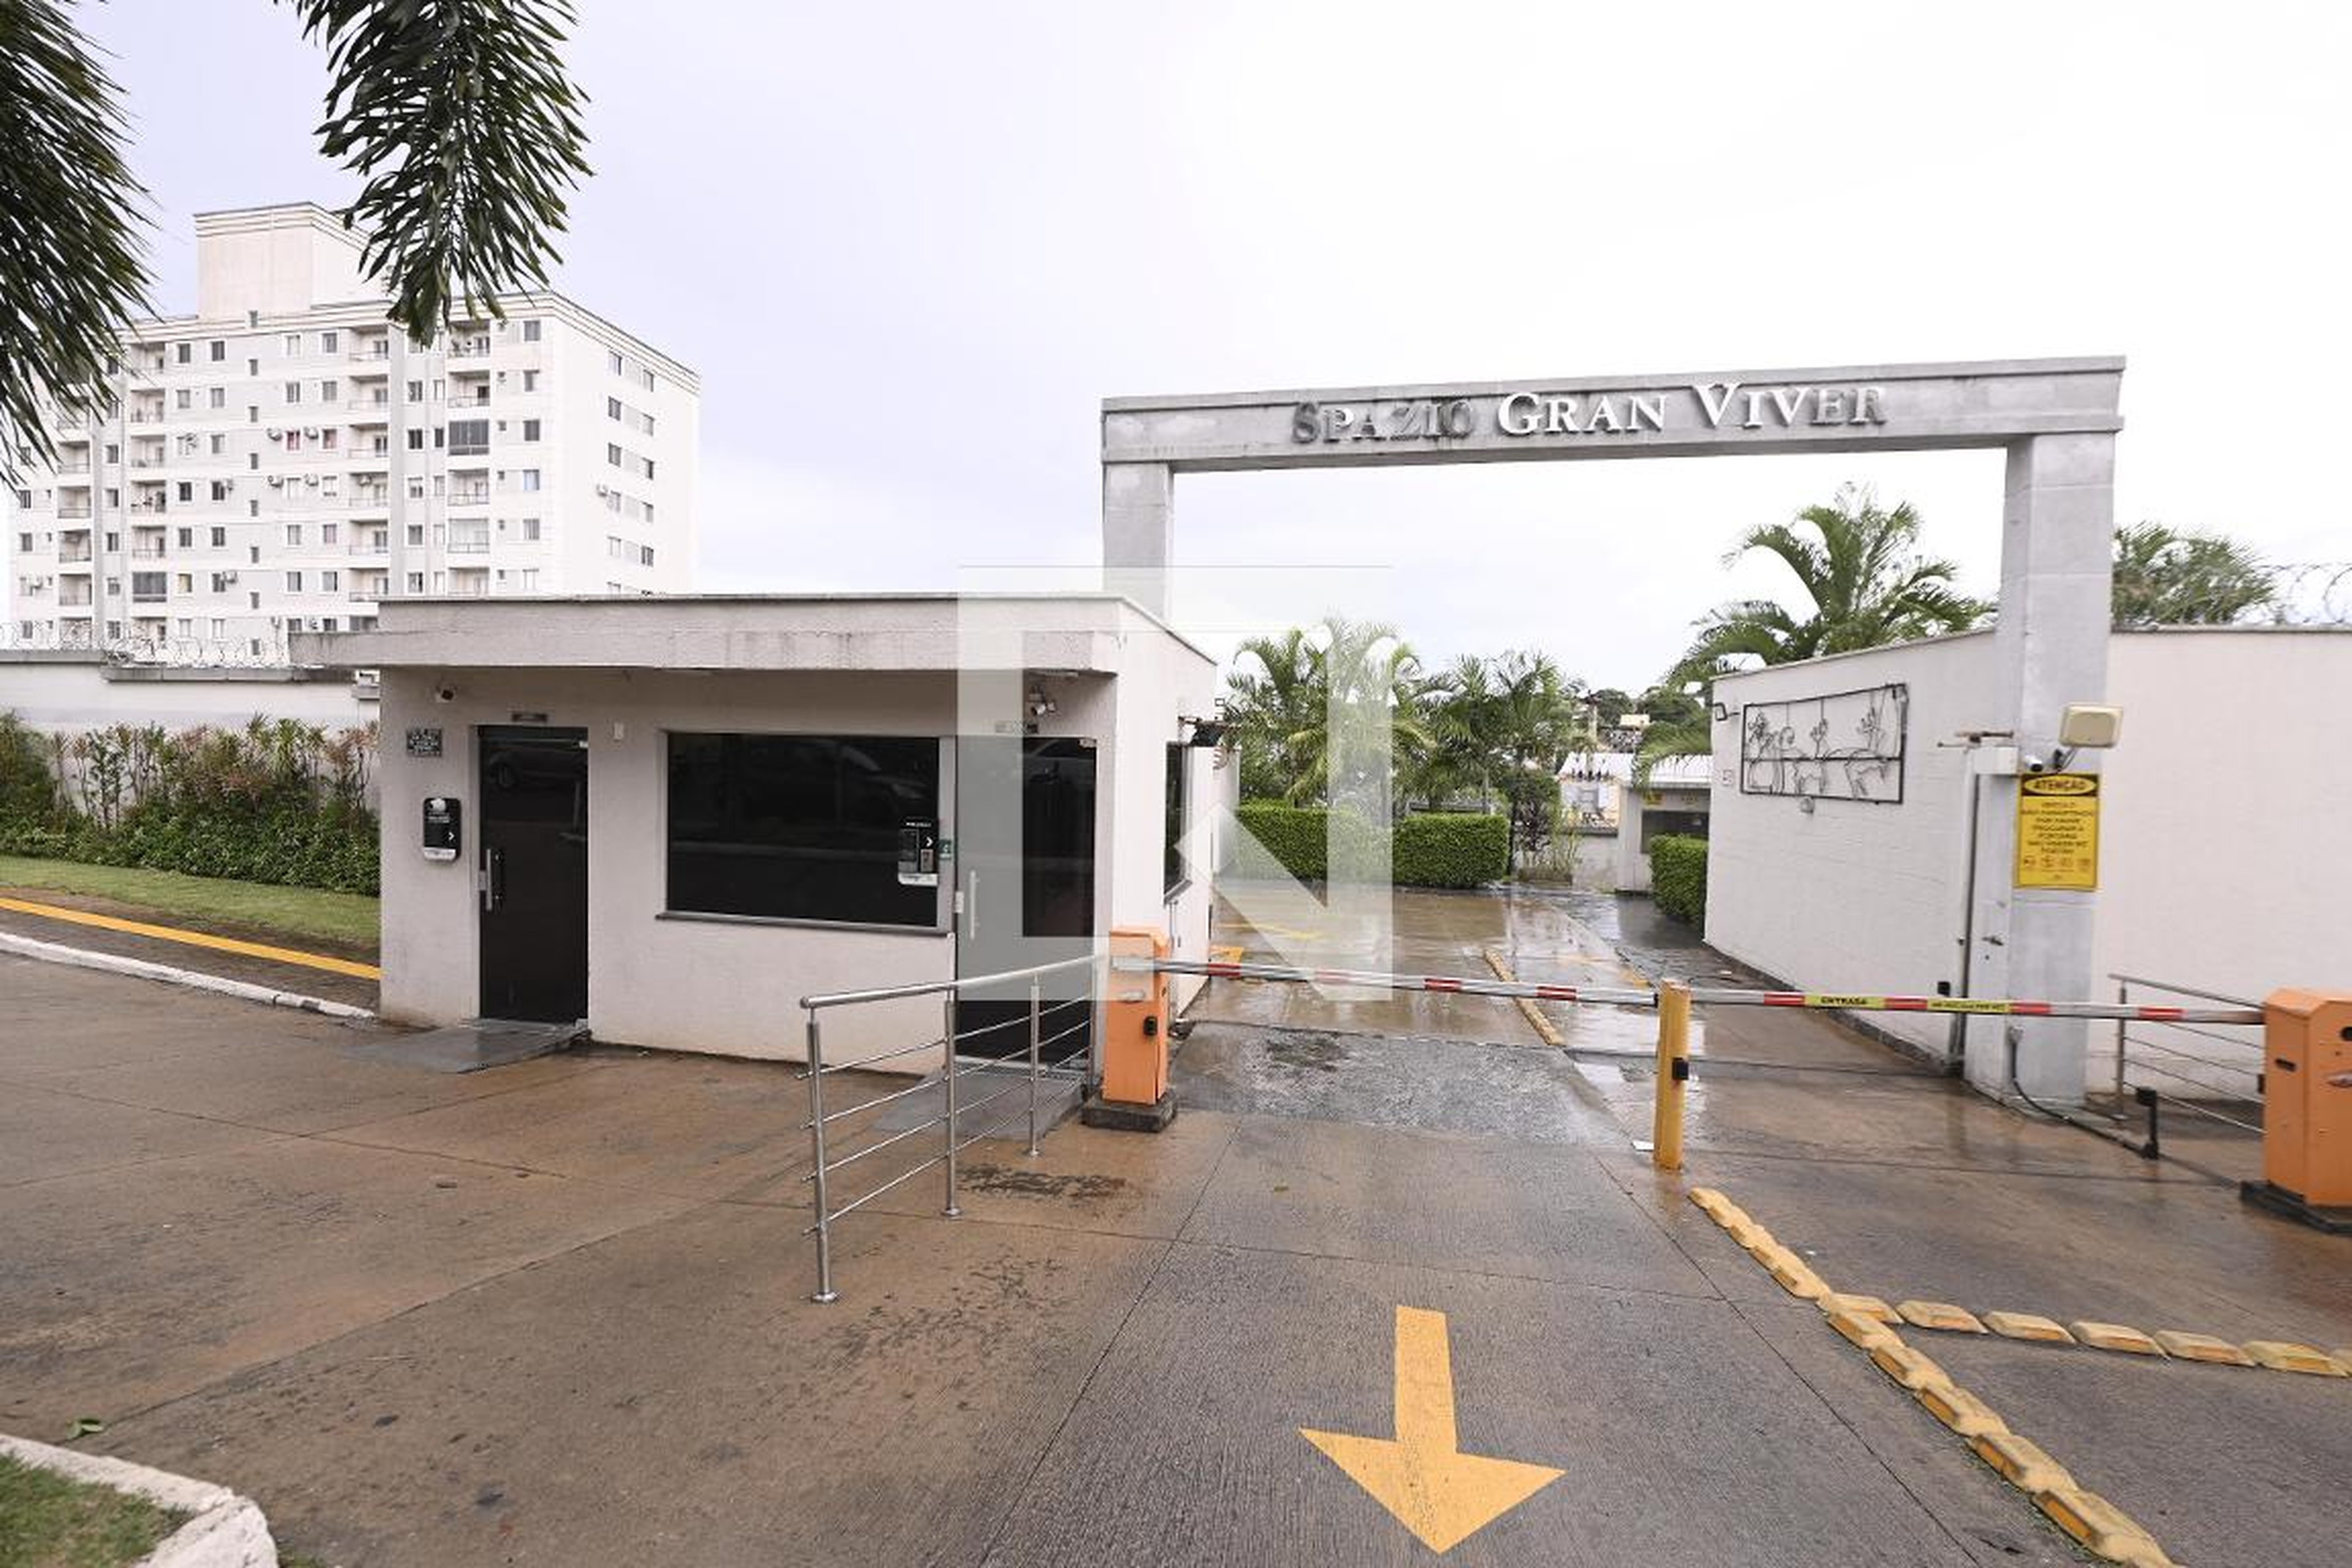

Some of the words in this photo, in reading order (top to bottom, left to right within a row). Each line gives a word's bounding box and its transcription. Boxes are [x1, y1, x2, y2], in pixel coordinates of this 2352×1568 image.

[1292, 399, 1472, 443] SPAZIO
[1498, 392, 1668, 435] GRAN
[1692, 382, 1887, 428] VIVER
